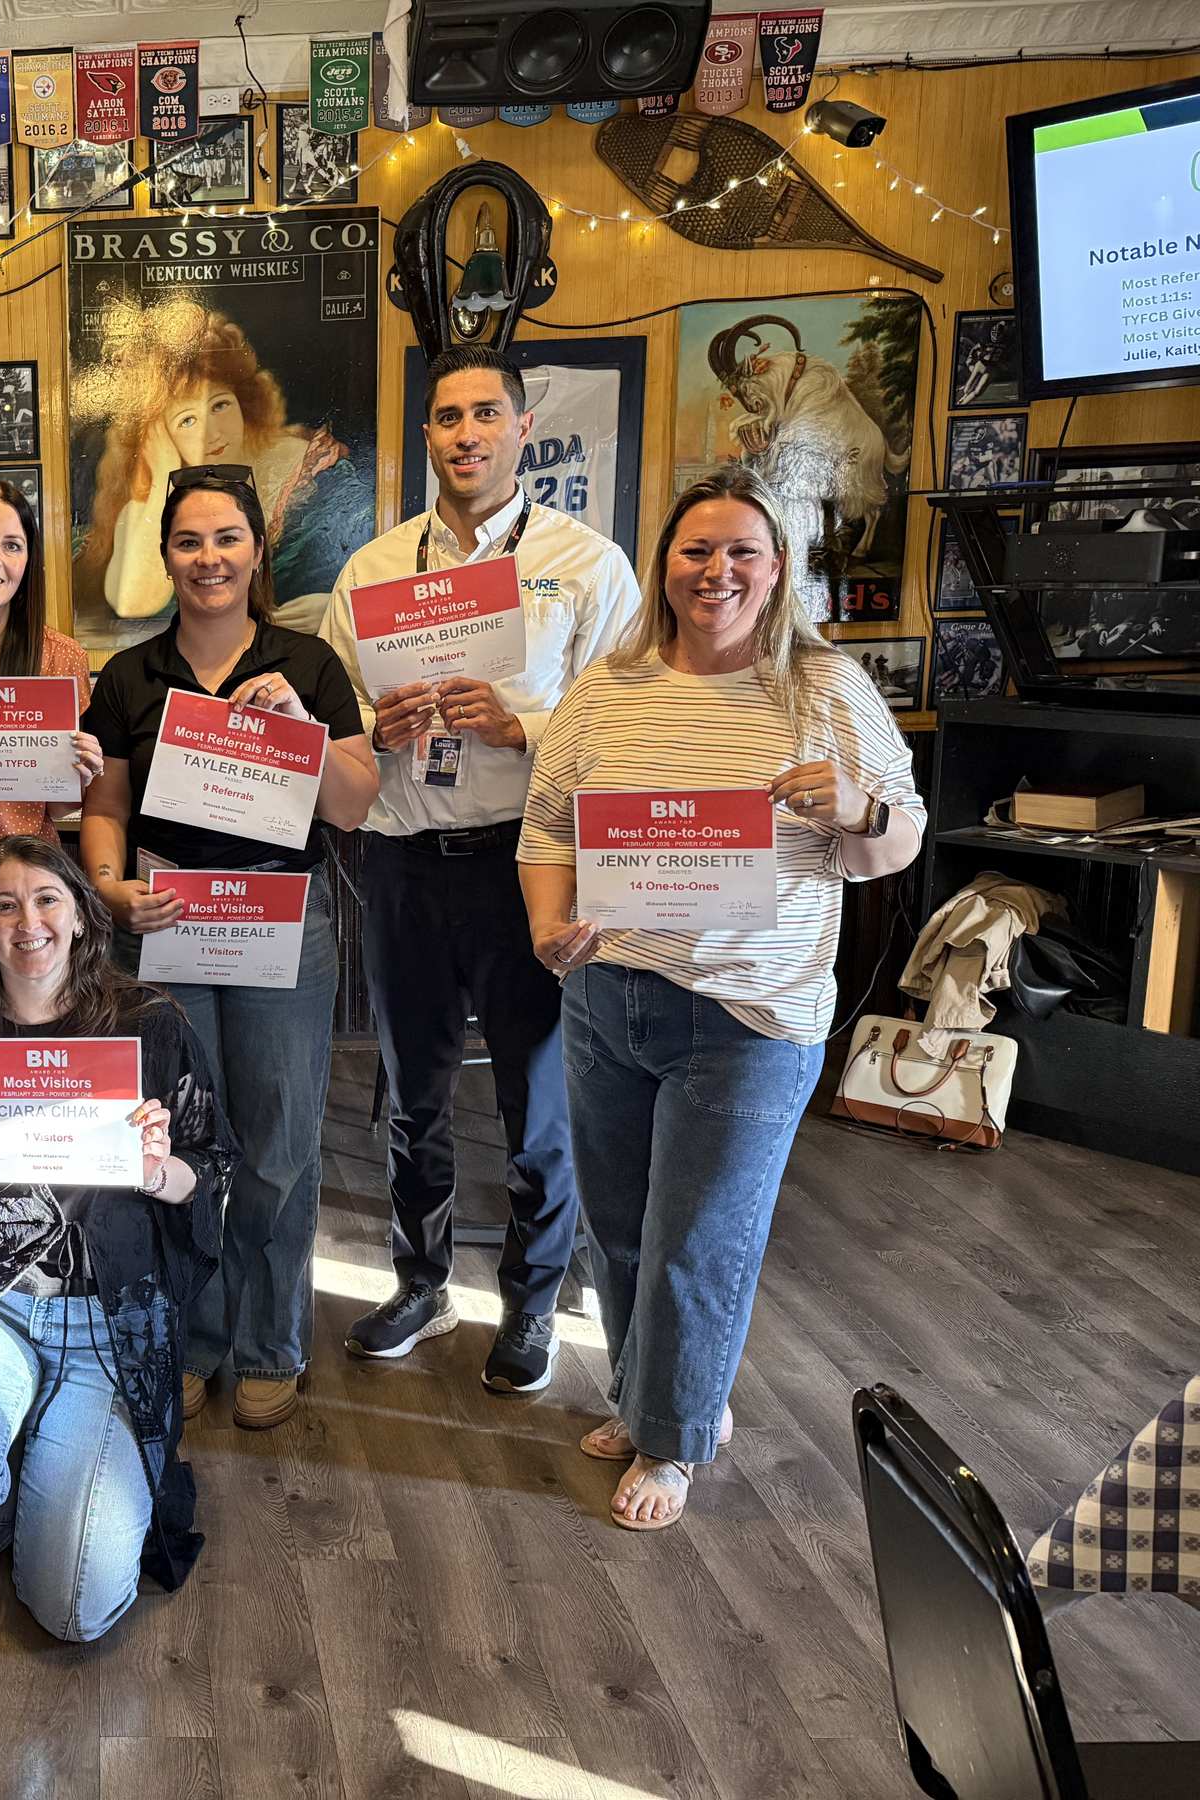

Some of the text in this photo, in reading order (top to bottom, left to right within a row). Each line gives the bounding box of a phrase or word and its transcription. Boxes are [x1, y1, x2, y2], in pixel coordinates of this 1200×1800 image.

[760, 23, 820, 36] CHAMPIONS
[312, 46, 368, 58] CHAMPIONS
[140, 55, 197, 66] CHAMPIONS
[326, 67, 353, 76] JETS
[701, 67, 743, 79] TUCKER
[701, 77, 744, 89] THOMAS
[89, 98, 124, 109] AARON
[158, 95, 180, 105] COM
[772, 101, 796, 109] TEXANS
[86, 107, 126, 119] SATTER
[152, 104, 186, 116] PUTER
[317, 108, 363, 123] 2015.2
[84, 119, 130, 133] 2016.1
[152, 115, 187, 130] 2016
[24, 123, 68, 136] 2016.2
[74, 223, 375, 260] BRASSY & CO.
[1089, 238, 1178, 266] Notable
[146, 260, 300, 282] KENTUCKY WHISKIES
[1122, 271, 1200, 290] Most Refer
[1122, 291, 1192, 309] Most 1:1s:
[1122, 311, 1169, 326] TYFCB
[1123, 330, 1159, 344] Most
[1123, 348, 1161, 361] Julie,
[515, 433, 586, 477] ADA
[534, 475, 588, 512] 26
[520, 578, 561, 591] PURE
[394, 599, 478, 624] Most Visitors
[376, 616, 505, 653] KAWIKA BURDINE
[420, 651, 467, 665] 1 Visitors
[2, 710, 43, 721] TYFCB
[174, 725, 311, 765] Most Referrals Passed
[5, 759, 37, 768] TYFCB
[183, 753, 290, 787] TAYLER BEALE
[202, 782, 255, 802] 9 Referrals
[607, 826, 741, 839] Most One-to-Ones
[596, 854, 754, 868] JENNY CROISETTE
[630, 880, 720, 891] 14 One-to-Ones
[189, 903, 265, 914] Most Visitors
[174, 925, 275, 938] TAYLER BEALE
[3, 1076, 92, 1089] Most Visitors
[51, 1105, 100, 1118] CIHAK
